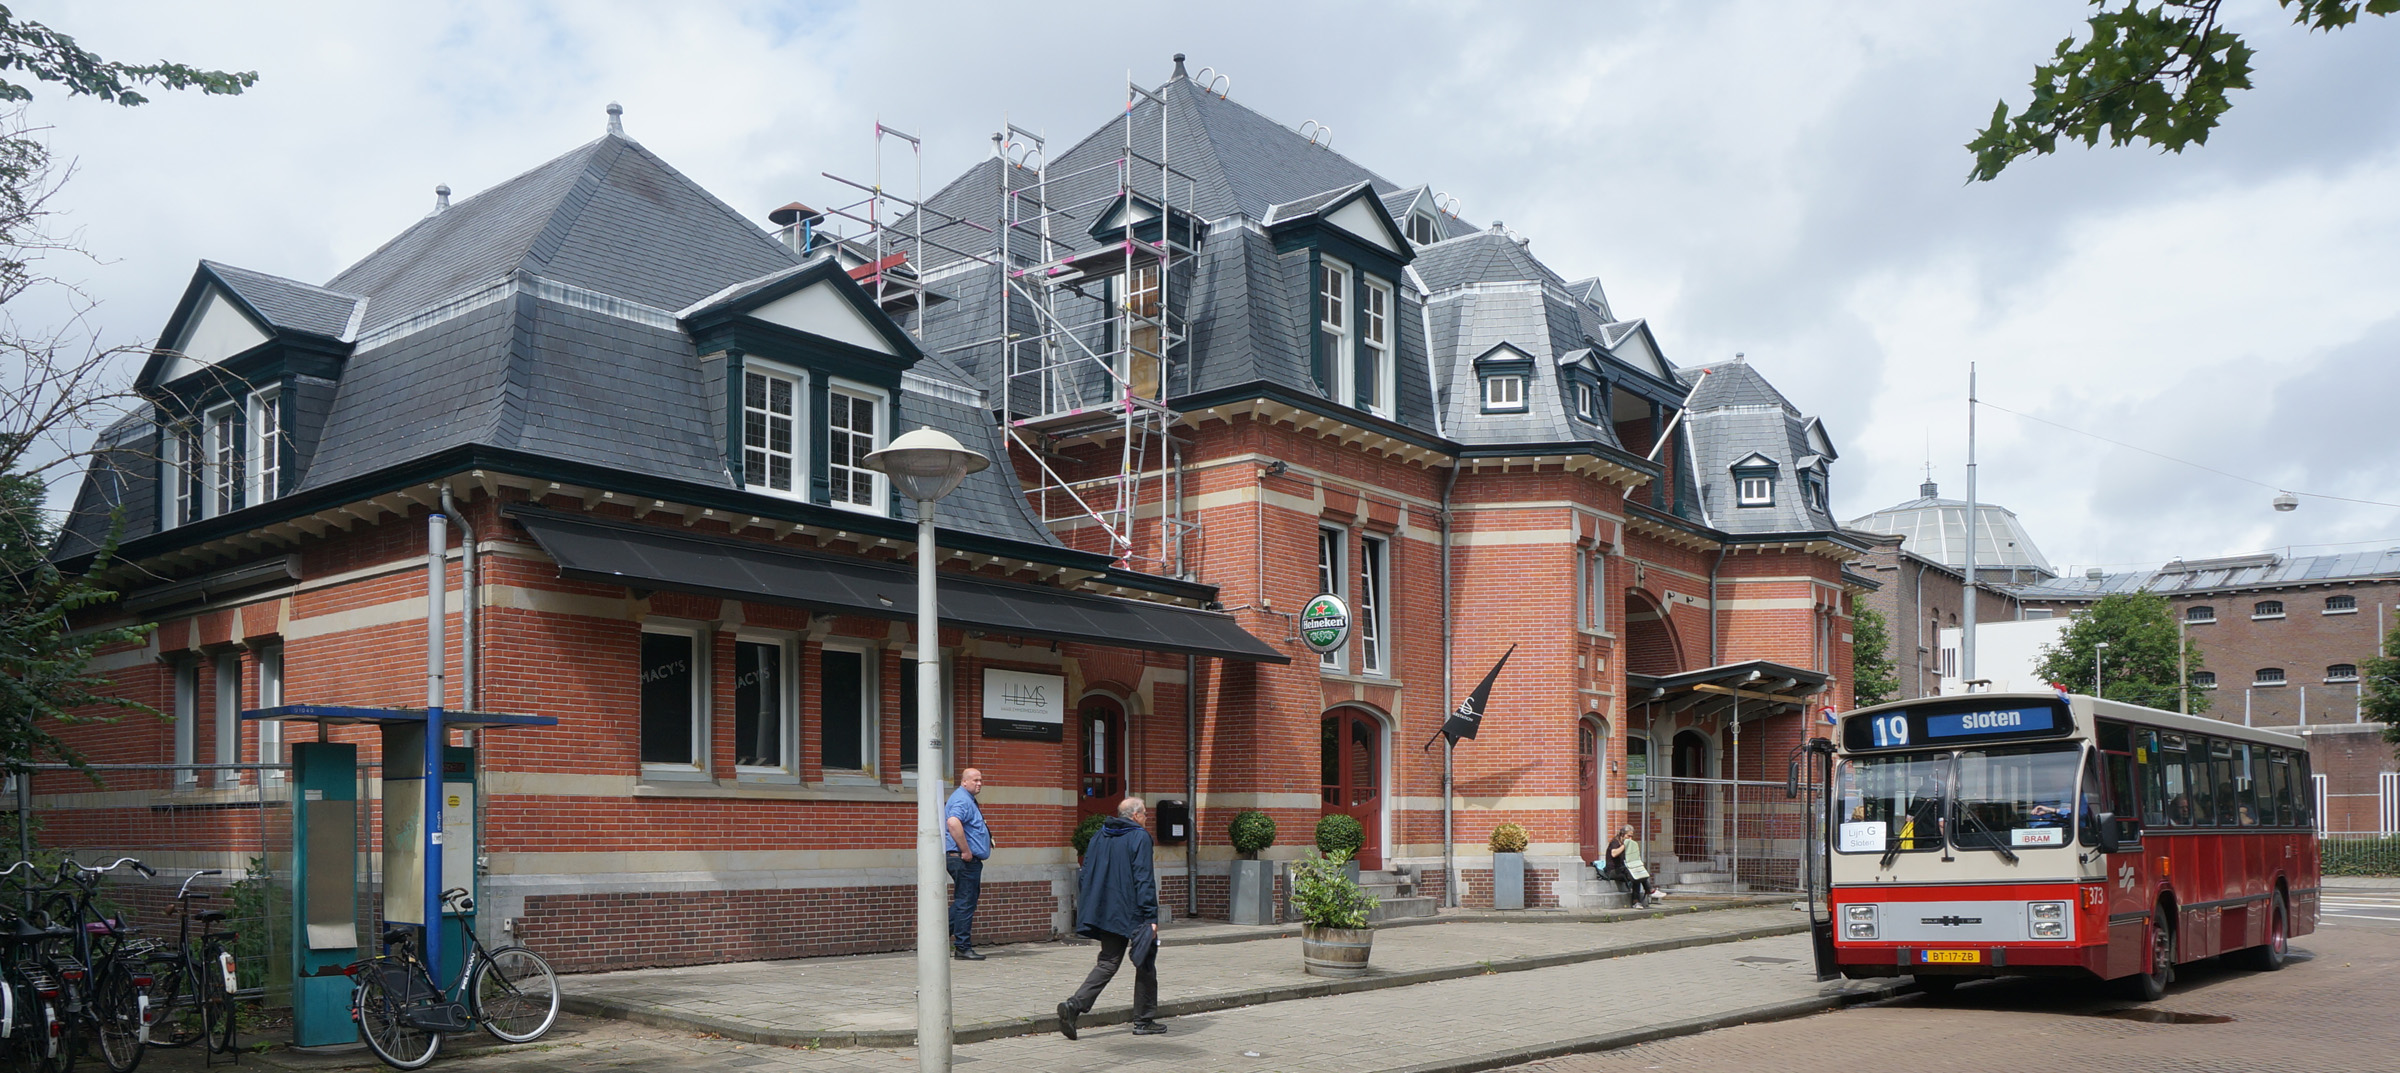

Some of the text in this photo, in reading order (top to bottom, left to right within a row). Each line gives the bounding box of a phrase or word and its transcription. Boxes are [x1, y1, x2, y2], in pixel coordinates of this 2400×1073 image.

[1303, 617, 1344, 630] Heineken
[735, 667, 770, 689] ACY'S
[1962, 711, 2021, 729] sloten
[1876, 715, 1908, 747] 19
[1848, 826, 1876, 838] Lijn G
[1850, 839, 1875, 848] Sloten
[2024, 835, 2051, 843] BRAM
[2089, 886, 2104, 905] 373
[1932, 952, 1974, 961] BT-17-ZB
